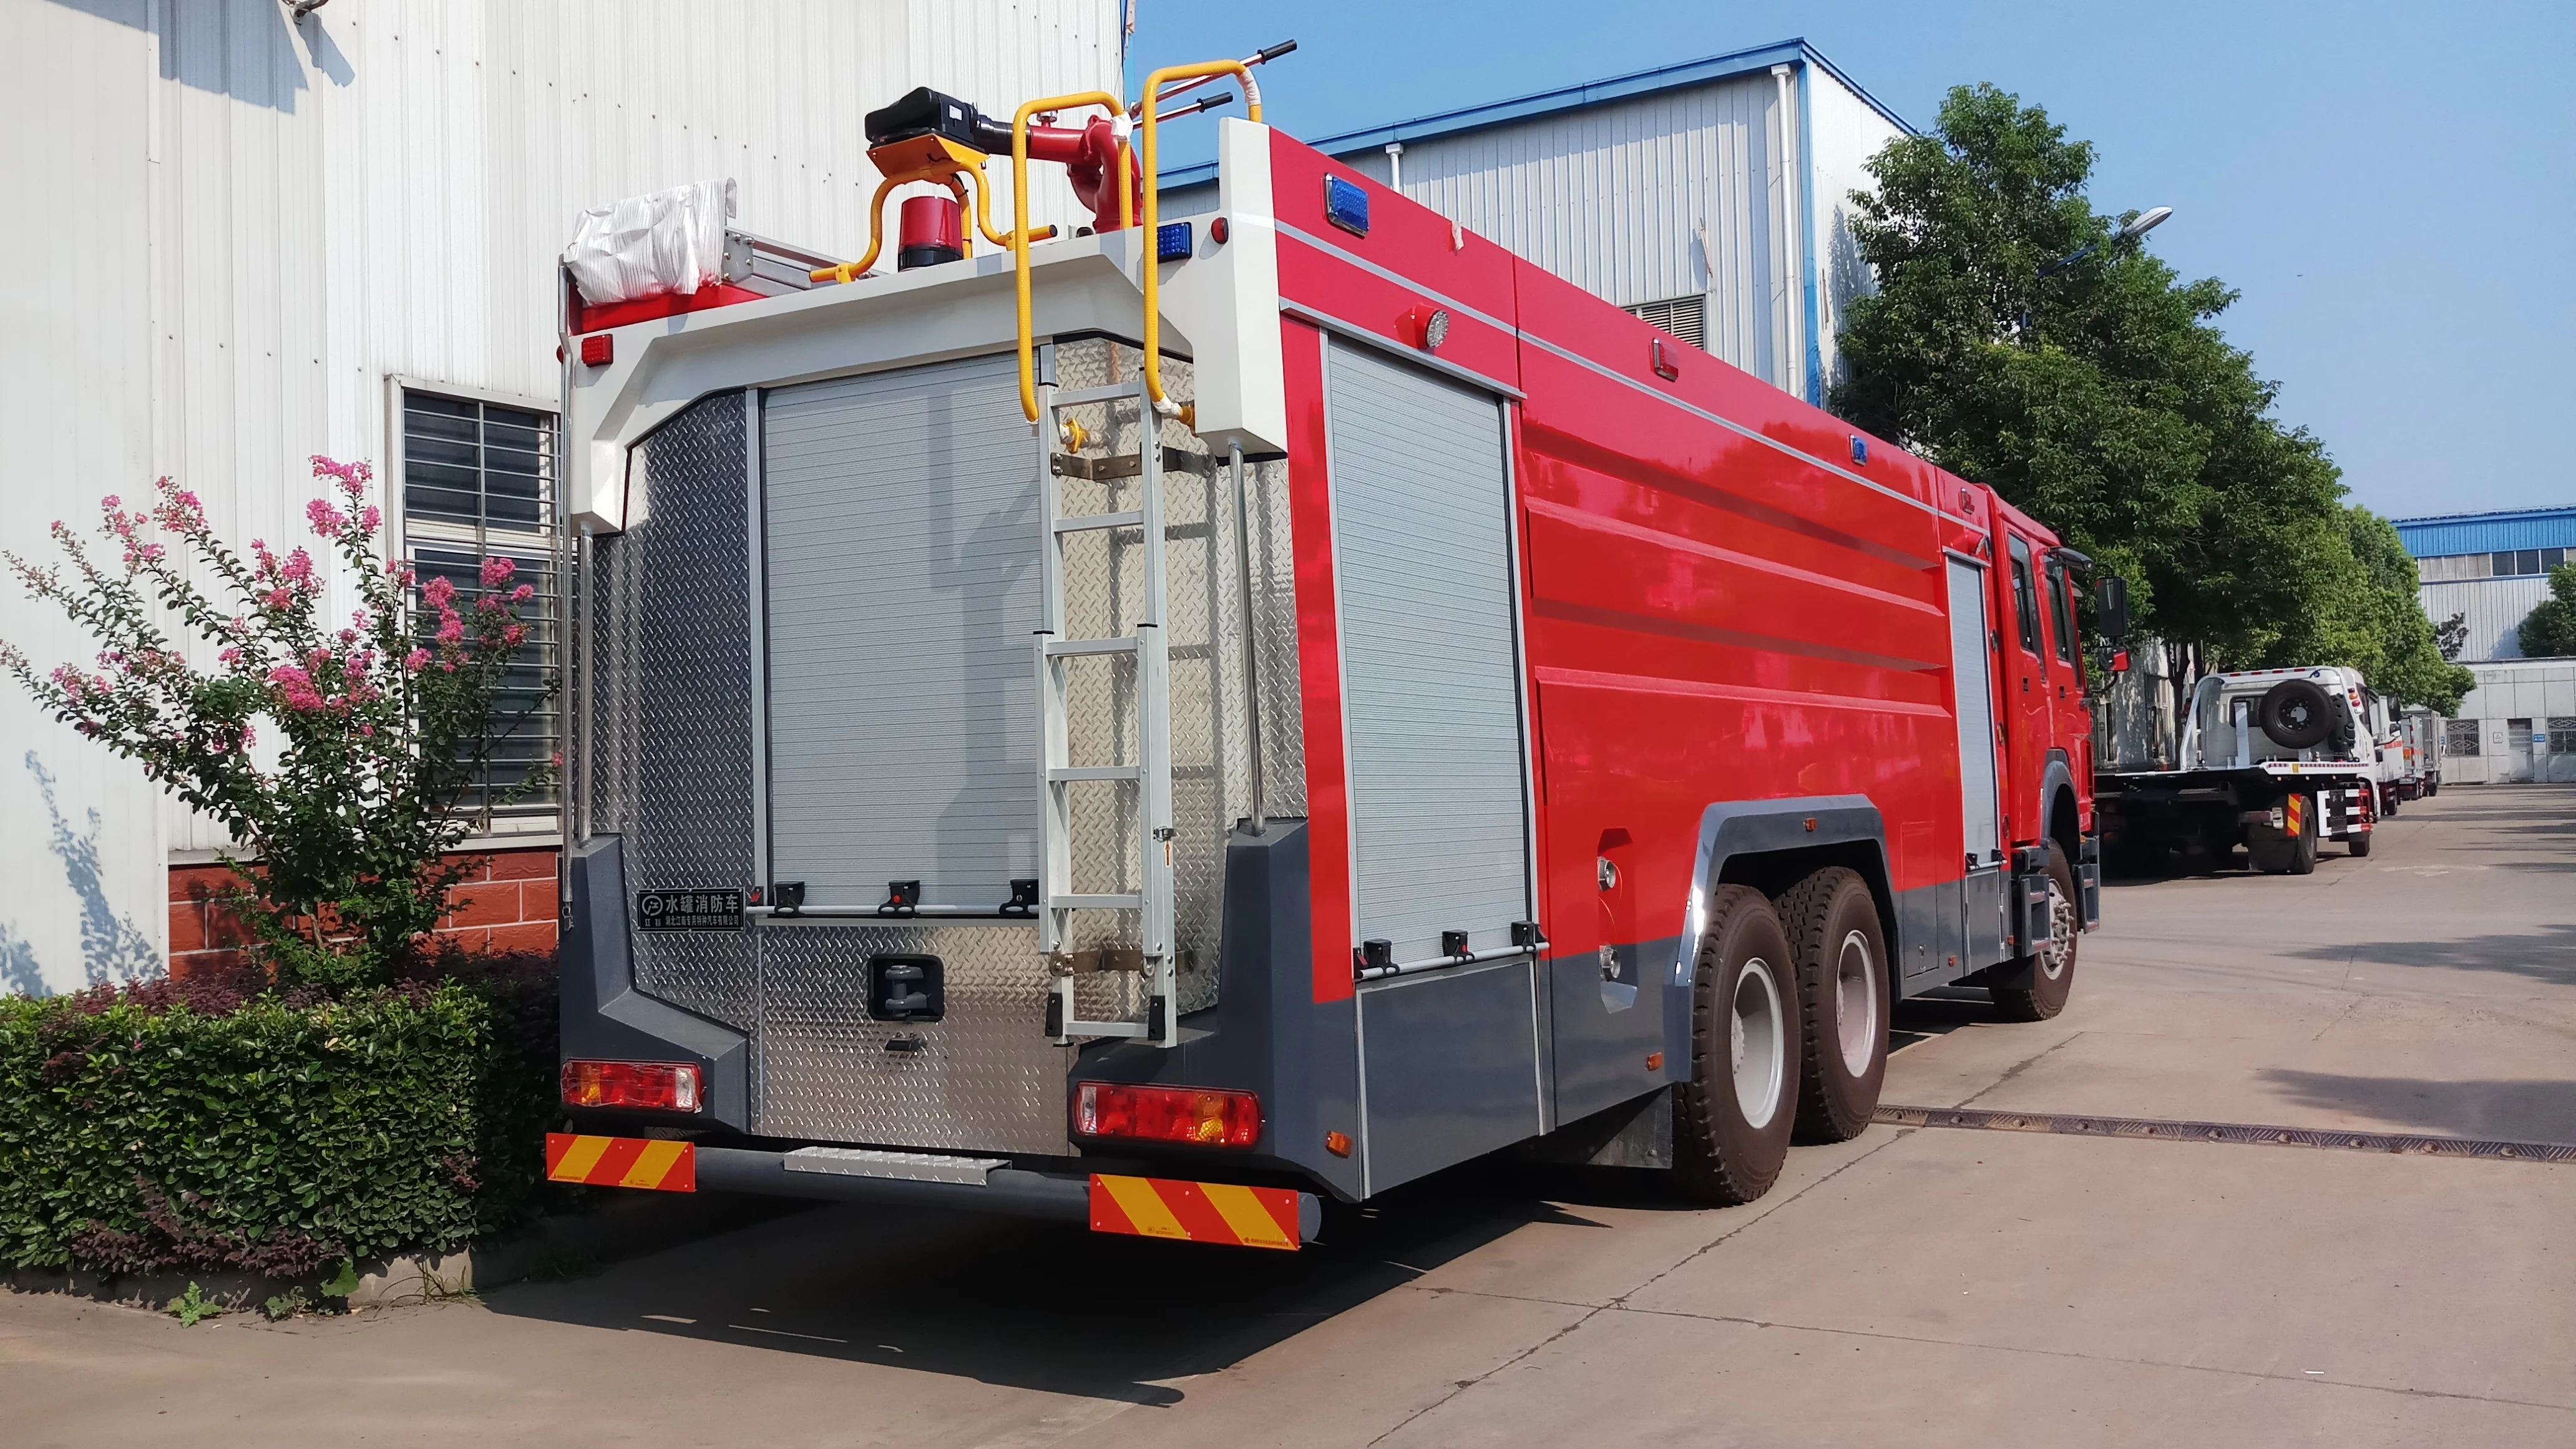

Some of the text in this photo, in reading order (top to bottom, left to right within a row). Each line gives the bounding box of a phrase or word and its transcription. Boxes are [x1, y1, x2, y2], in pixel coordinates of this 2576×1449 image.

[666, 894, 738, 914] 水罐消防车
